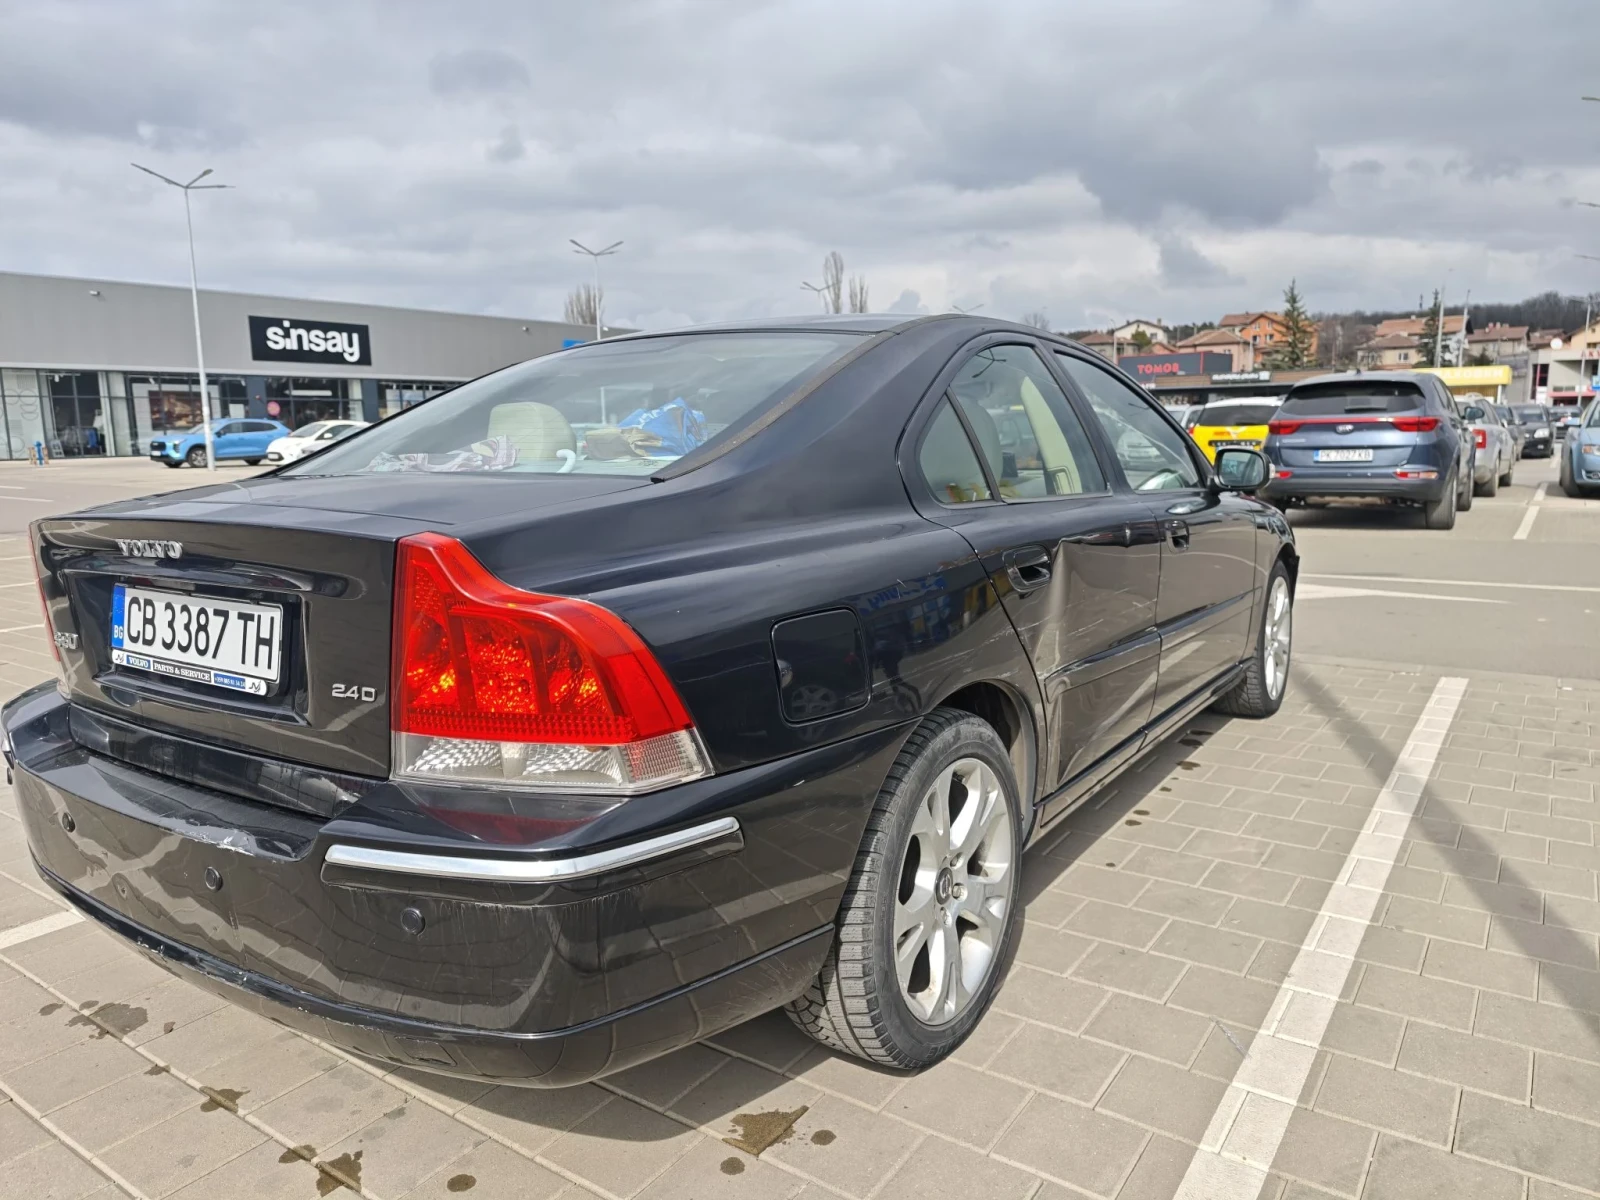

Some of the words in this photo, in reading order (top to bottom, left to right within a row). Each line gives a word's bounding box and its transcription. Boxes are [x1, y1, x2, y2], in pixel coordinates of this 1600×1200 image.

[266, 320, 360, 362] sinsay
[118, 539, 183, 559] VOLVO
[114, 625, 124, 639] BG
[127, 597, 156, 646] CB
[161, 602, 230, 659] 3387
[237, 612, 275, 670] TH
[128, 656, 149, 668] VOLVO
[154, 662, 174, 674] PARTS
[181, 668, 210, 681] SERVICE
